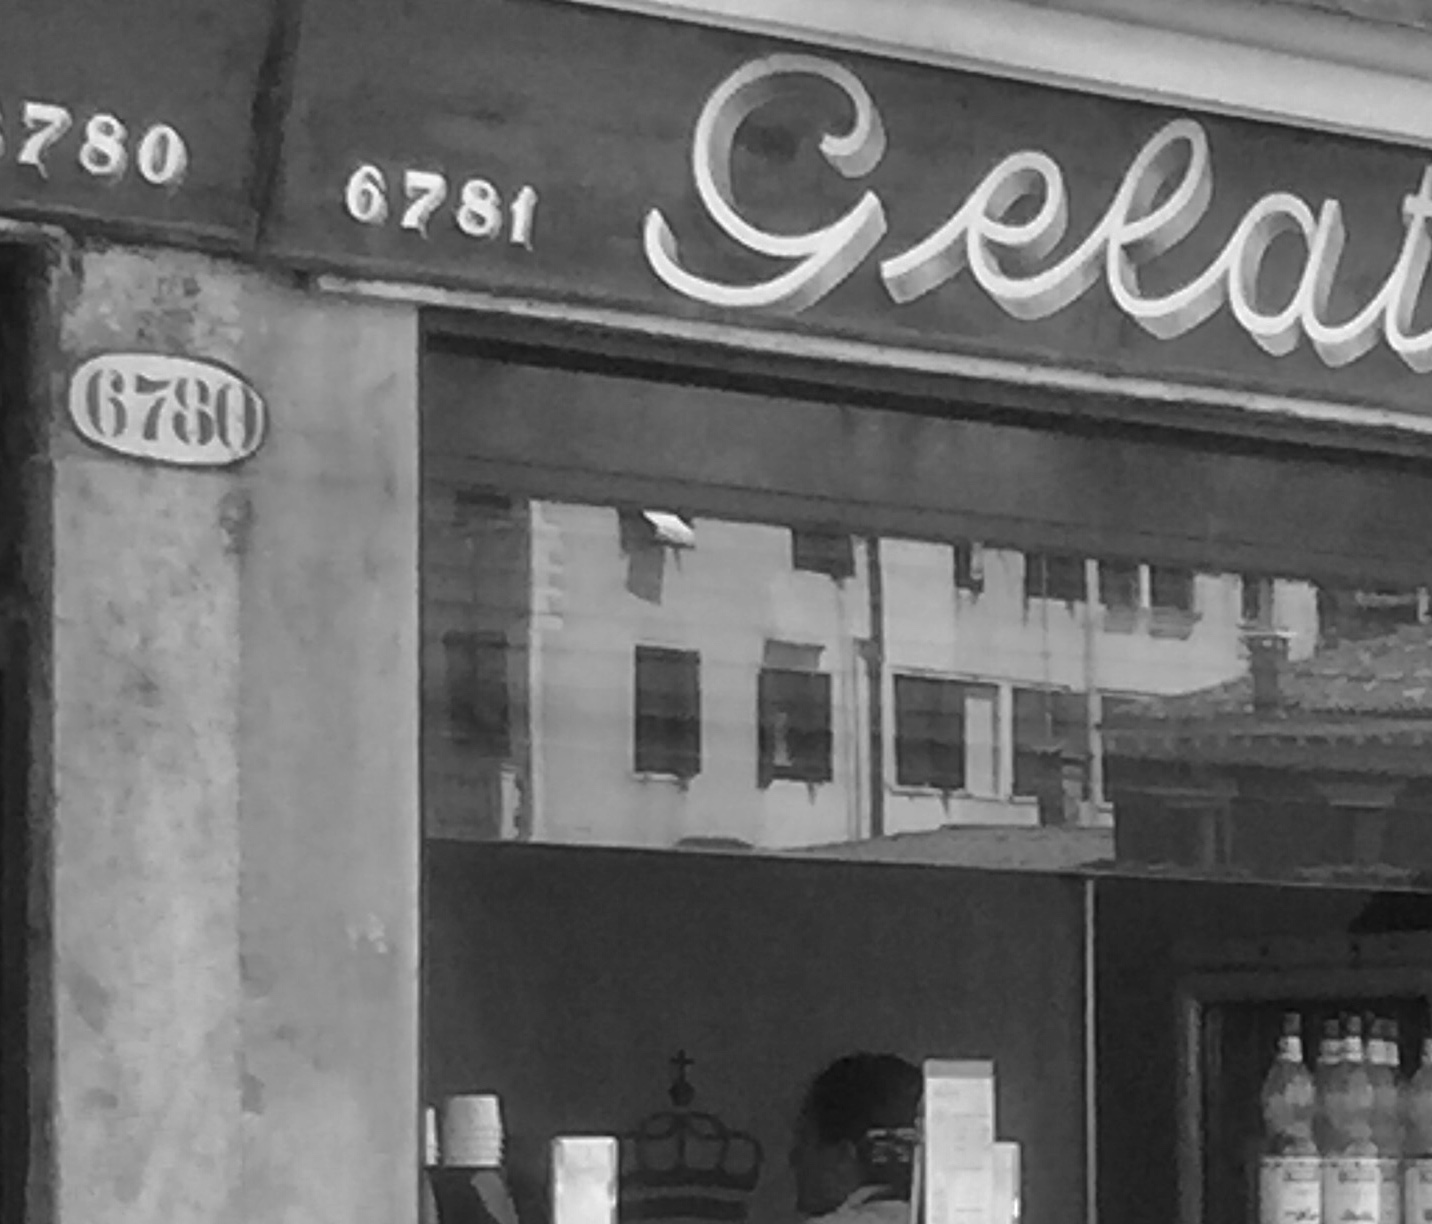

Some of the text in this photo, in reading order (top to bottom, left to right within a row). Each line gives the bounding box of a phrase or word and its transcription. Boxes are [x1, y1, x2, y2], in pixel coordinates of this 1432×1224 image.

[0, 101, 190, 192] 780
[344, 163, 538, 252] 6781
[85, 365, 261, 455] 6780
